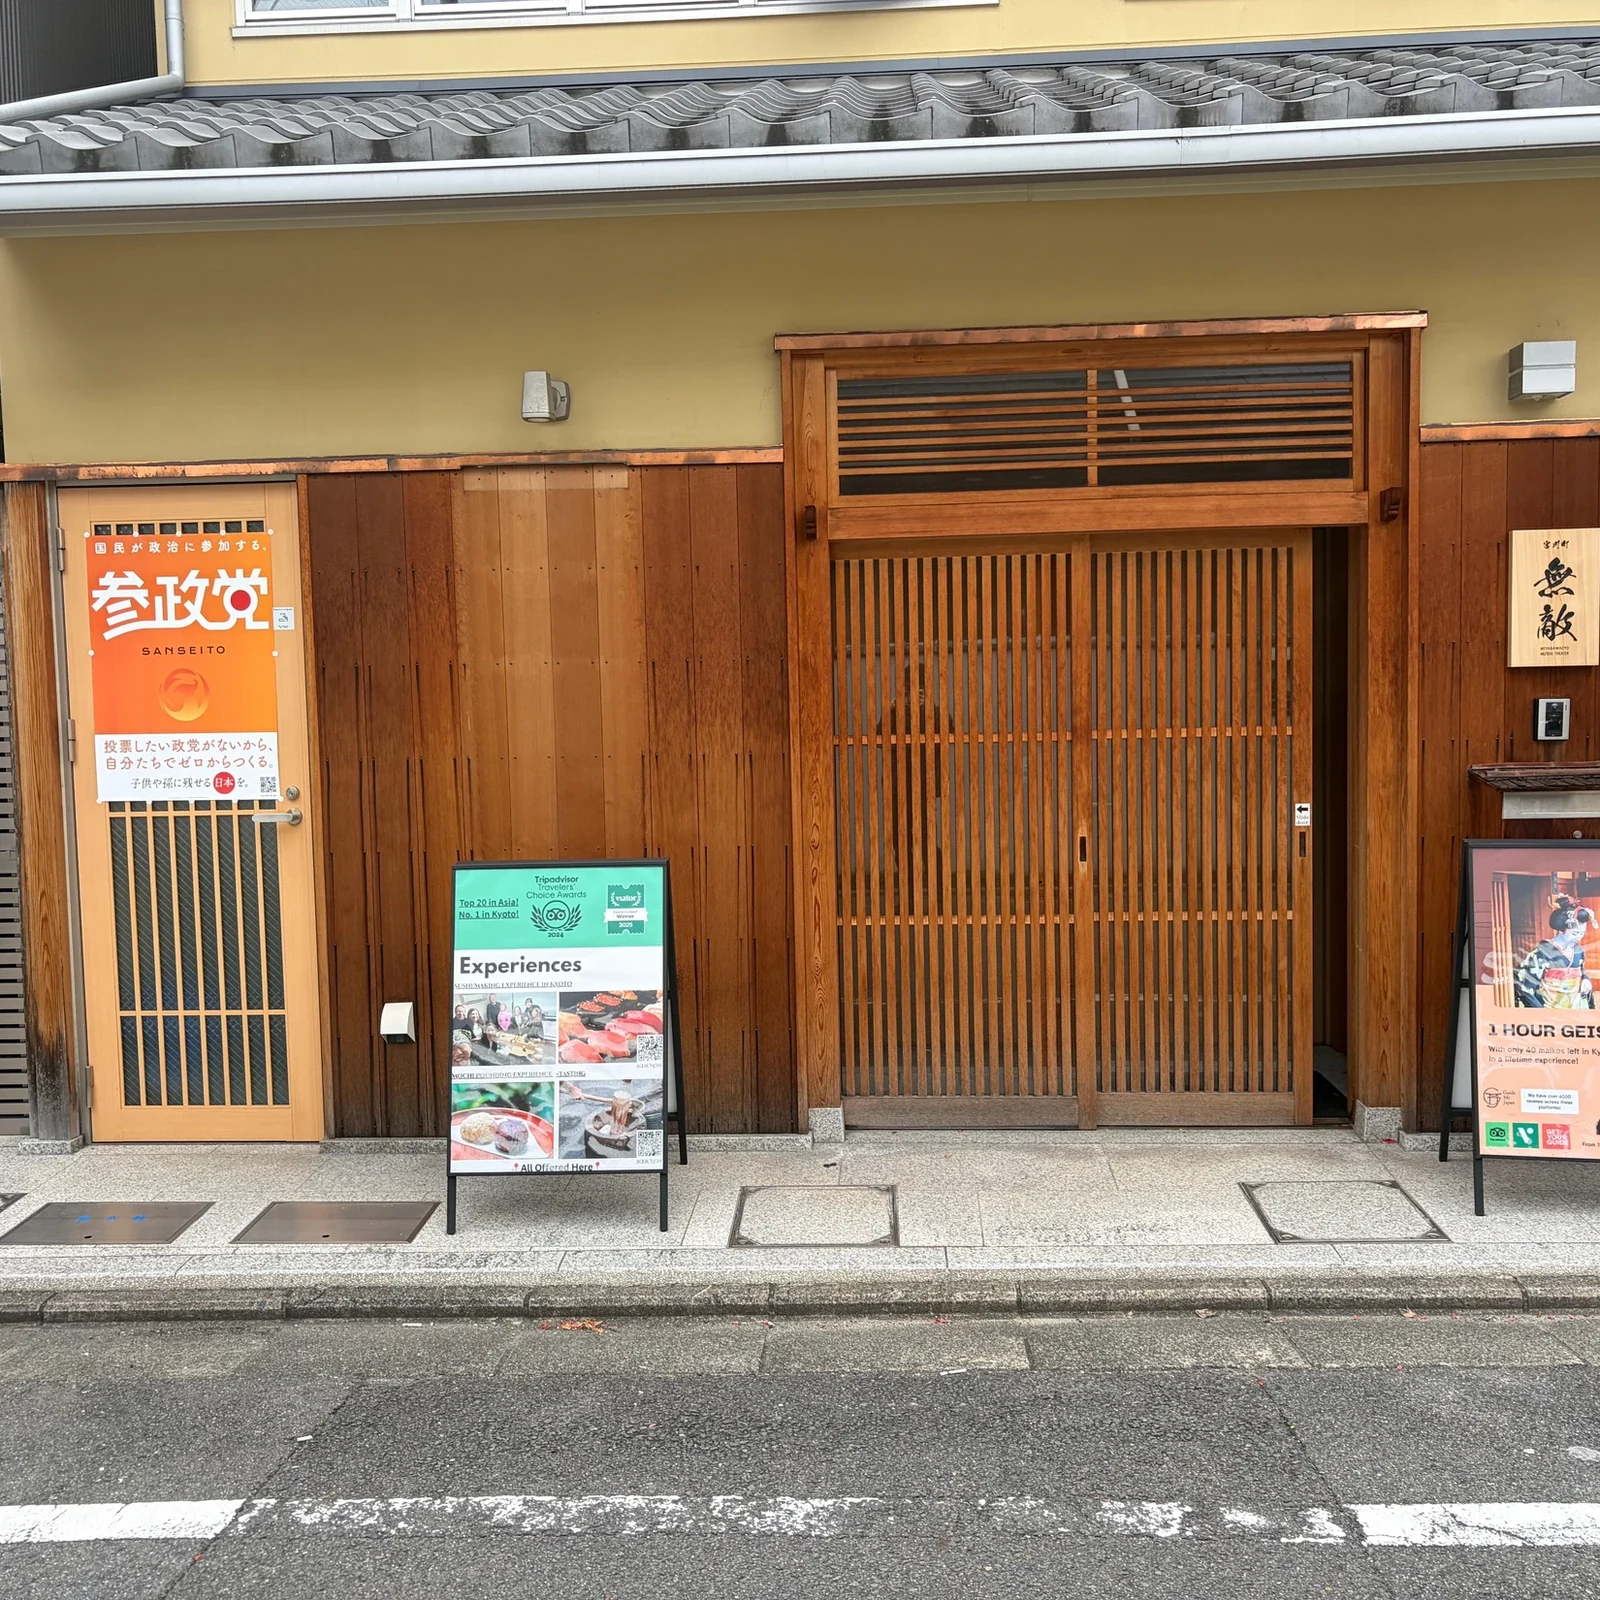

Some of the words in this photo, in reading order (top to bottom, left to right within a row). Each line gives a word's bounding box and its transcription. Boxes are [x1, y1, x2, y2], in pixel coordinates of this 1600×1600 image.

[94, 539, 267, 554] 国民が政治に参加する。
[91, 568, 270, 641] 参政党
[1533, 557, 1578, 641] 無敵
[142, 646, 226, 656] SANSEITO
[104, 738, 274, 754] 投票したい政党がないから、
[106, 756, 274, 770] 自分たちでゼロからつくる。
[130, 775, 249, 790] 子供や孫に残せる日本を。
[534, 876, 579, 884] Tripadvisor
[557, 890, 587, 898] Awards
[460, 900, 474, 908] Top
[499, 898, 519, 906] Asia!
[492, 910, 519, 919] Kyoto!
[460, 956, 582, 978] Experiences
[1488, 1024, 1498, 1036] 1
[1503, 1024, 1555, 1037] HOUR
[521, 1163, 532, 1172] All
[535, 1163, 569, 1172] Offered
[572, 1163, 593, 1171] Here
